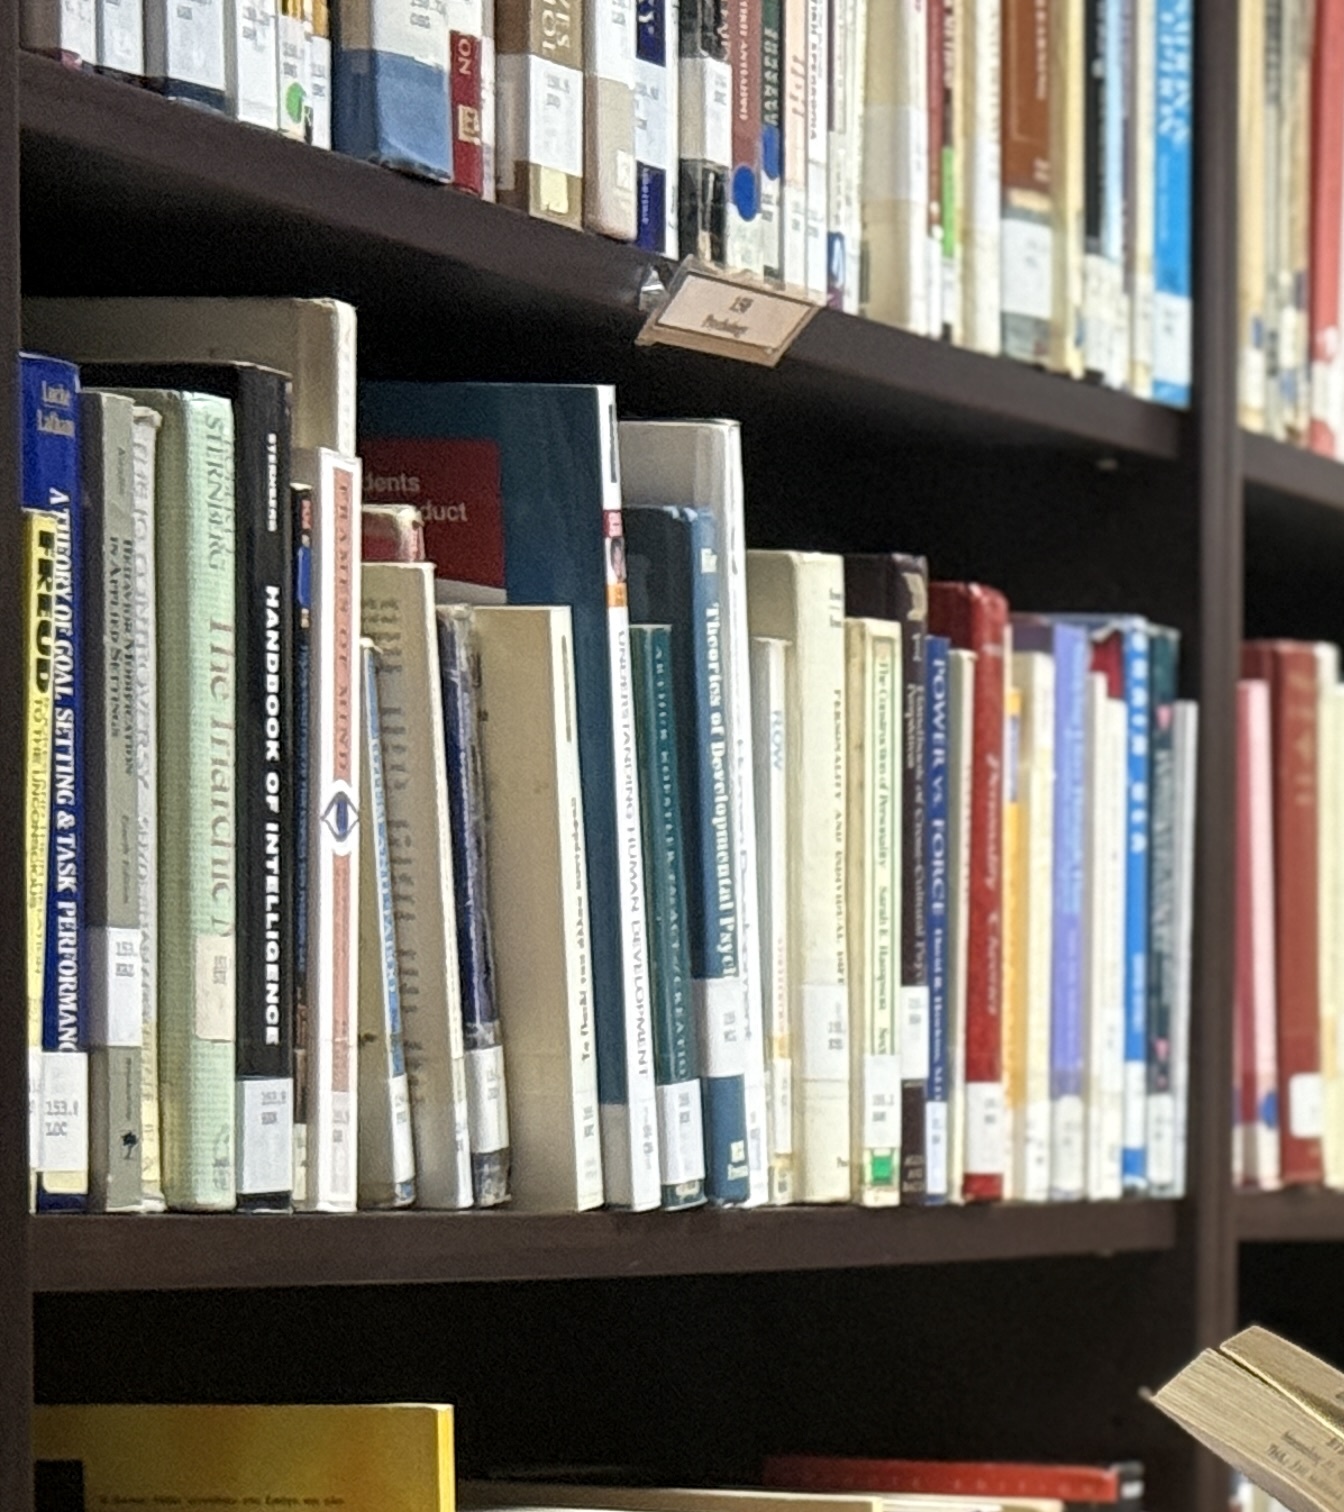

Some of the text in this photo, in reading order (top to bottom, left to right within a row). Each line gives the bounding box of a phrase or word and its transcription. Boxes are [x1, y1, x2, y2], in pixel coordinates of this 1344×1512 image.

[50, 487, 70, 505] A
[205, 412, 225, 571] STERNBERG
[53, 508, 74, 601] THEORY
[338, 483, 350, 614] FRAMES
[36, 529, 56, 695] FREUD
[54, 603, 74, 634] OF
[208, 617, 235, 700] The
[54, 706, 76, 805] SETTING
[338, 684, 350, 781] MIND
[932, 658, 947, 767] POWER
[56, 811, 76, 829] &
[265, 584, 280, 1046] HANDBOOK OF INTELLIGENCE
[705, 602, 739, 978] Theories of Developmental Psych
[56, 833, 77, 893] TASK
[619, 629, 649, 1078] UNDERSTANDING HUMAN DEVELOPMENT
[932, 817, 947, 917] FORCE
[57, 901, 79, 1053] PERFORMANC
